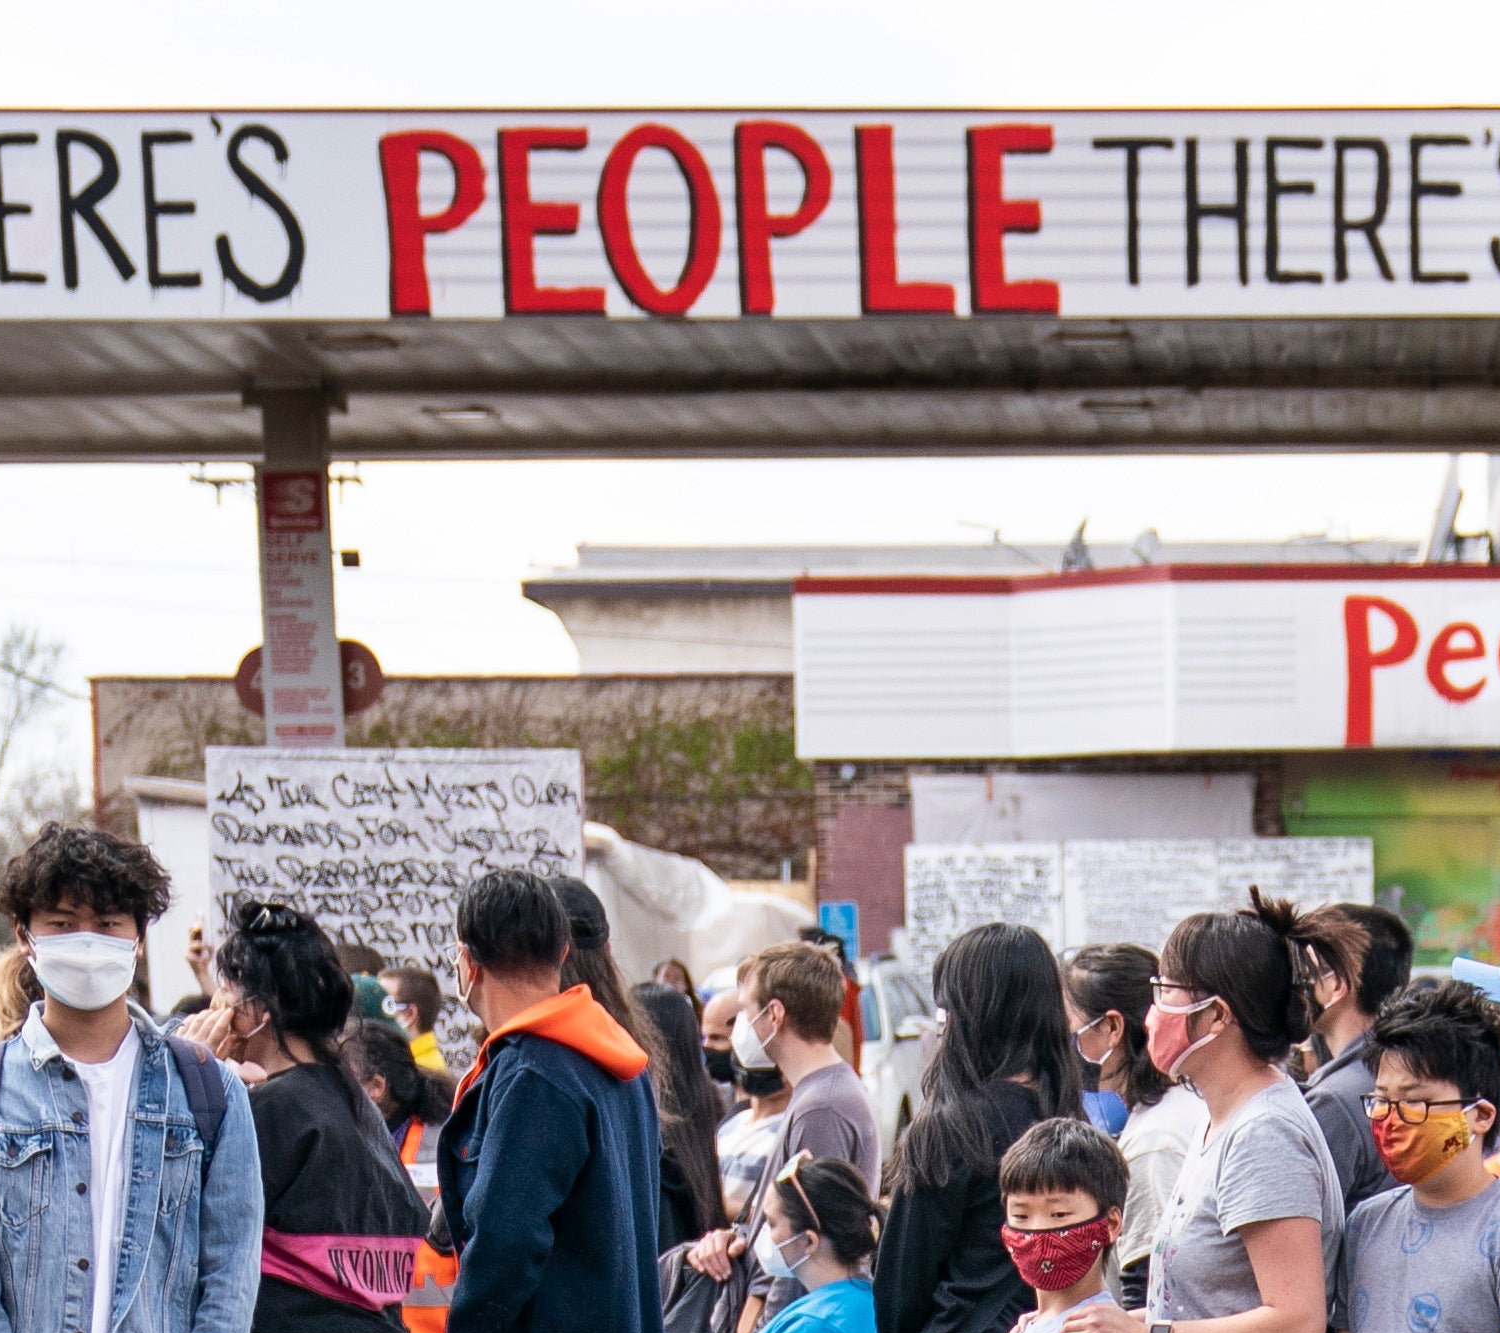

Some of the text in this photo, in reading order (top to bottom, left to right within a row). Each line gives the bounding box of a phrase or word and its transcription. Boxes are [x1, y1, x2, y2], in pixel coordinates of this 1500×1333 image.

[379, 121, 1059, 317] PEOPLE
[347, 660, 366, 690] 3
[328, 1248, 415, 1294] WYOMING
